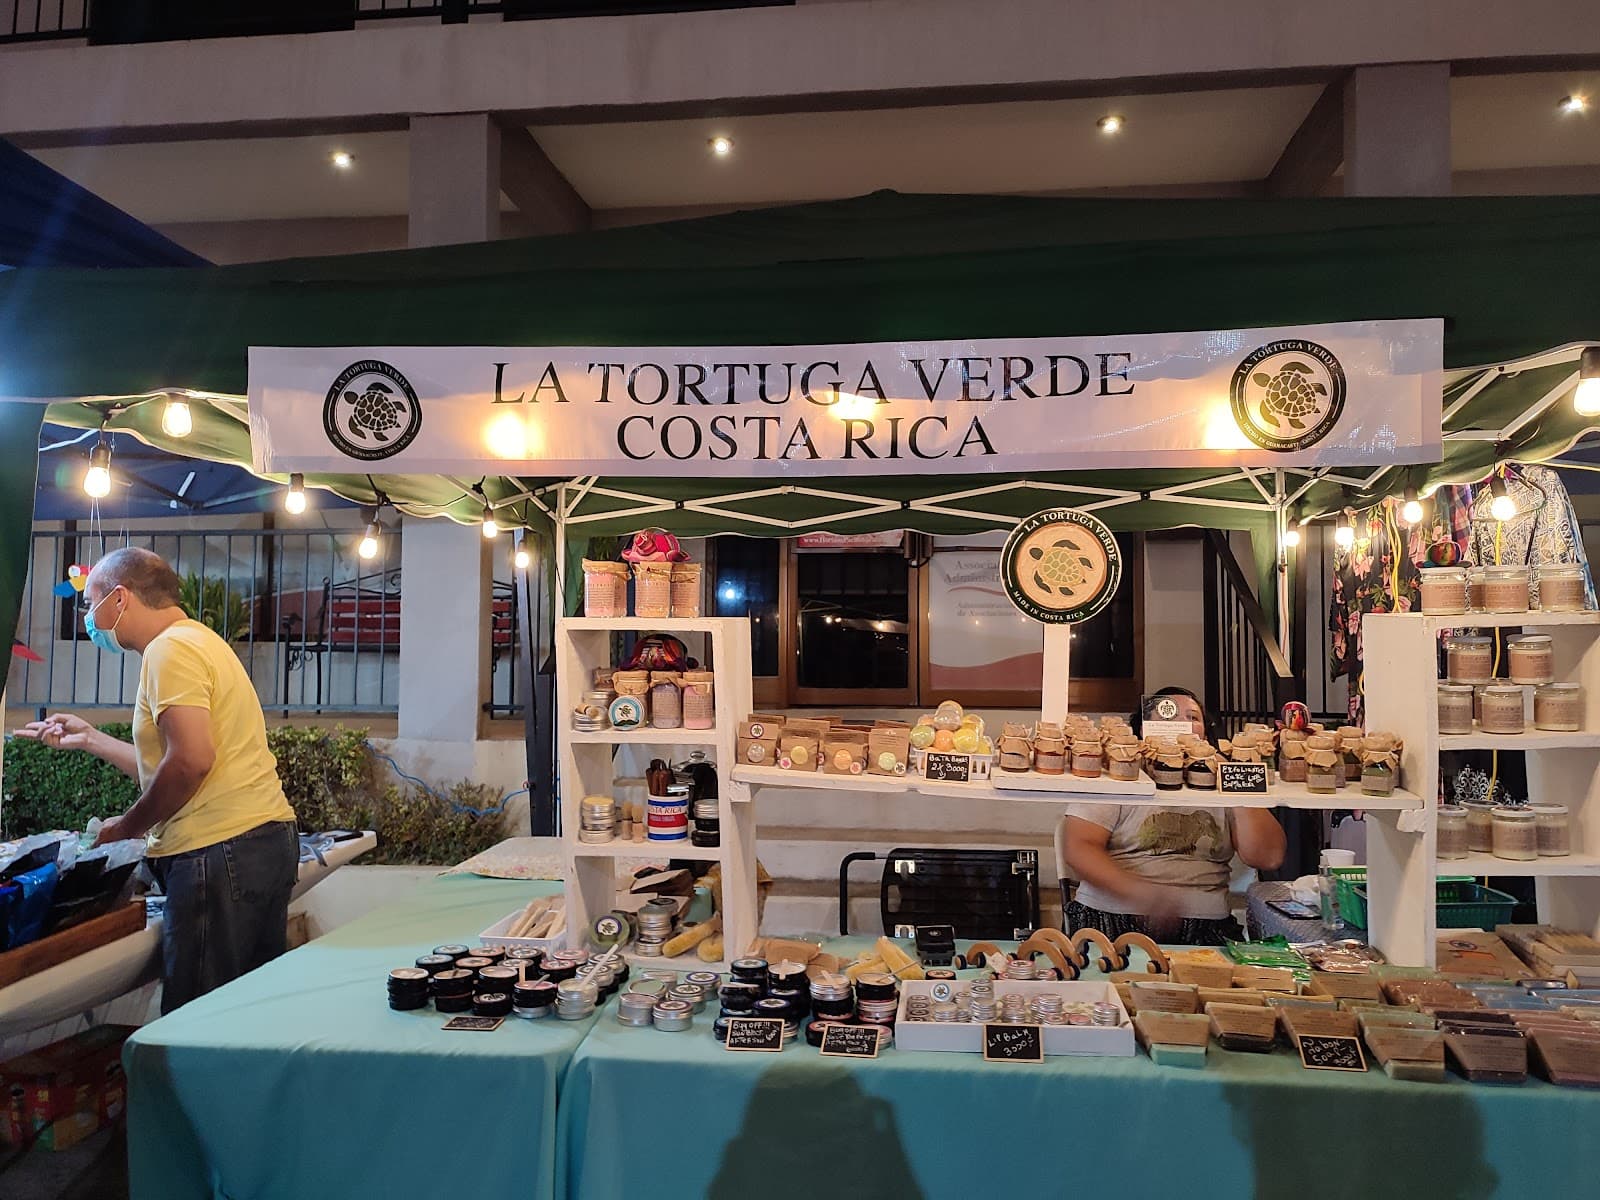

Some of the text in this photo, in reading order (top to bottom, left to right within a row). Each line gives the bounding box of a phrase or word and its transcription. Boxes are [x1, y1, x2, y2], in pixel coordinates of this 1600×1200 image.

[491, 352, 1136, 407] LA TORTUGA VERDE
[1239, 341, 1338, 376] LA TORTUGA VERDE
[616, 414, 999, 462] COSTA RICA
[1023, 511, 1117, 562] LA TORTUGA VERDE
[1013, 590, 1085, 621] MADE IN COSTA RICA
